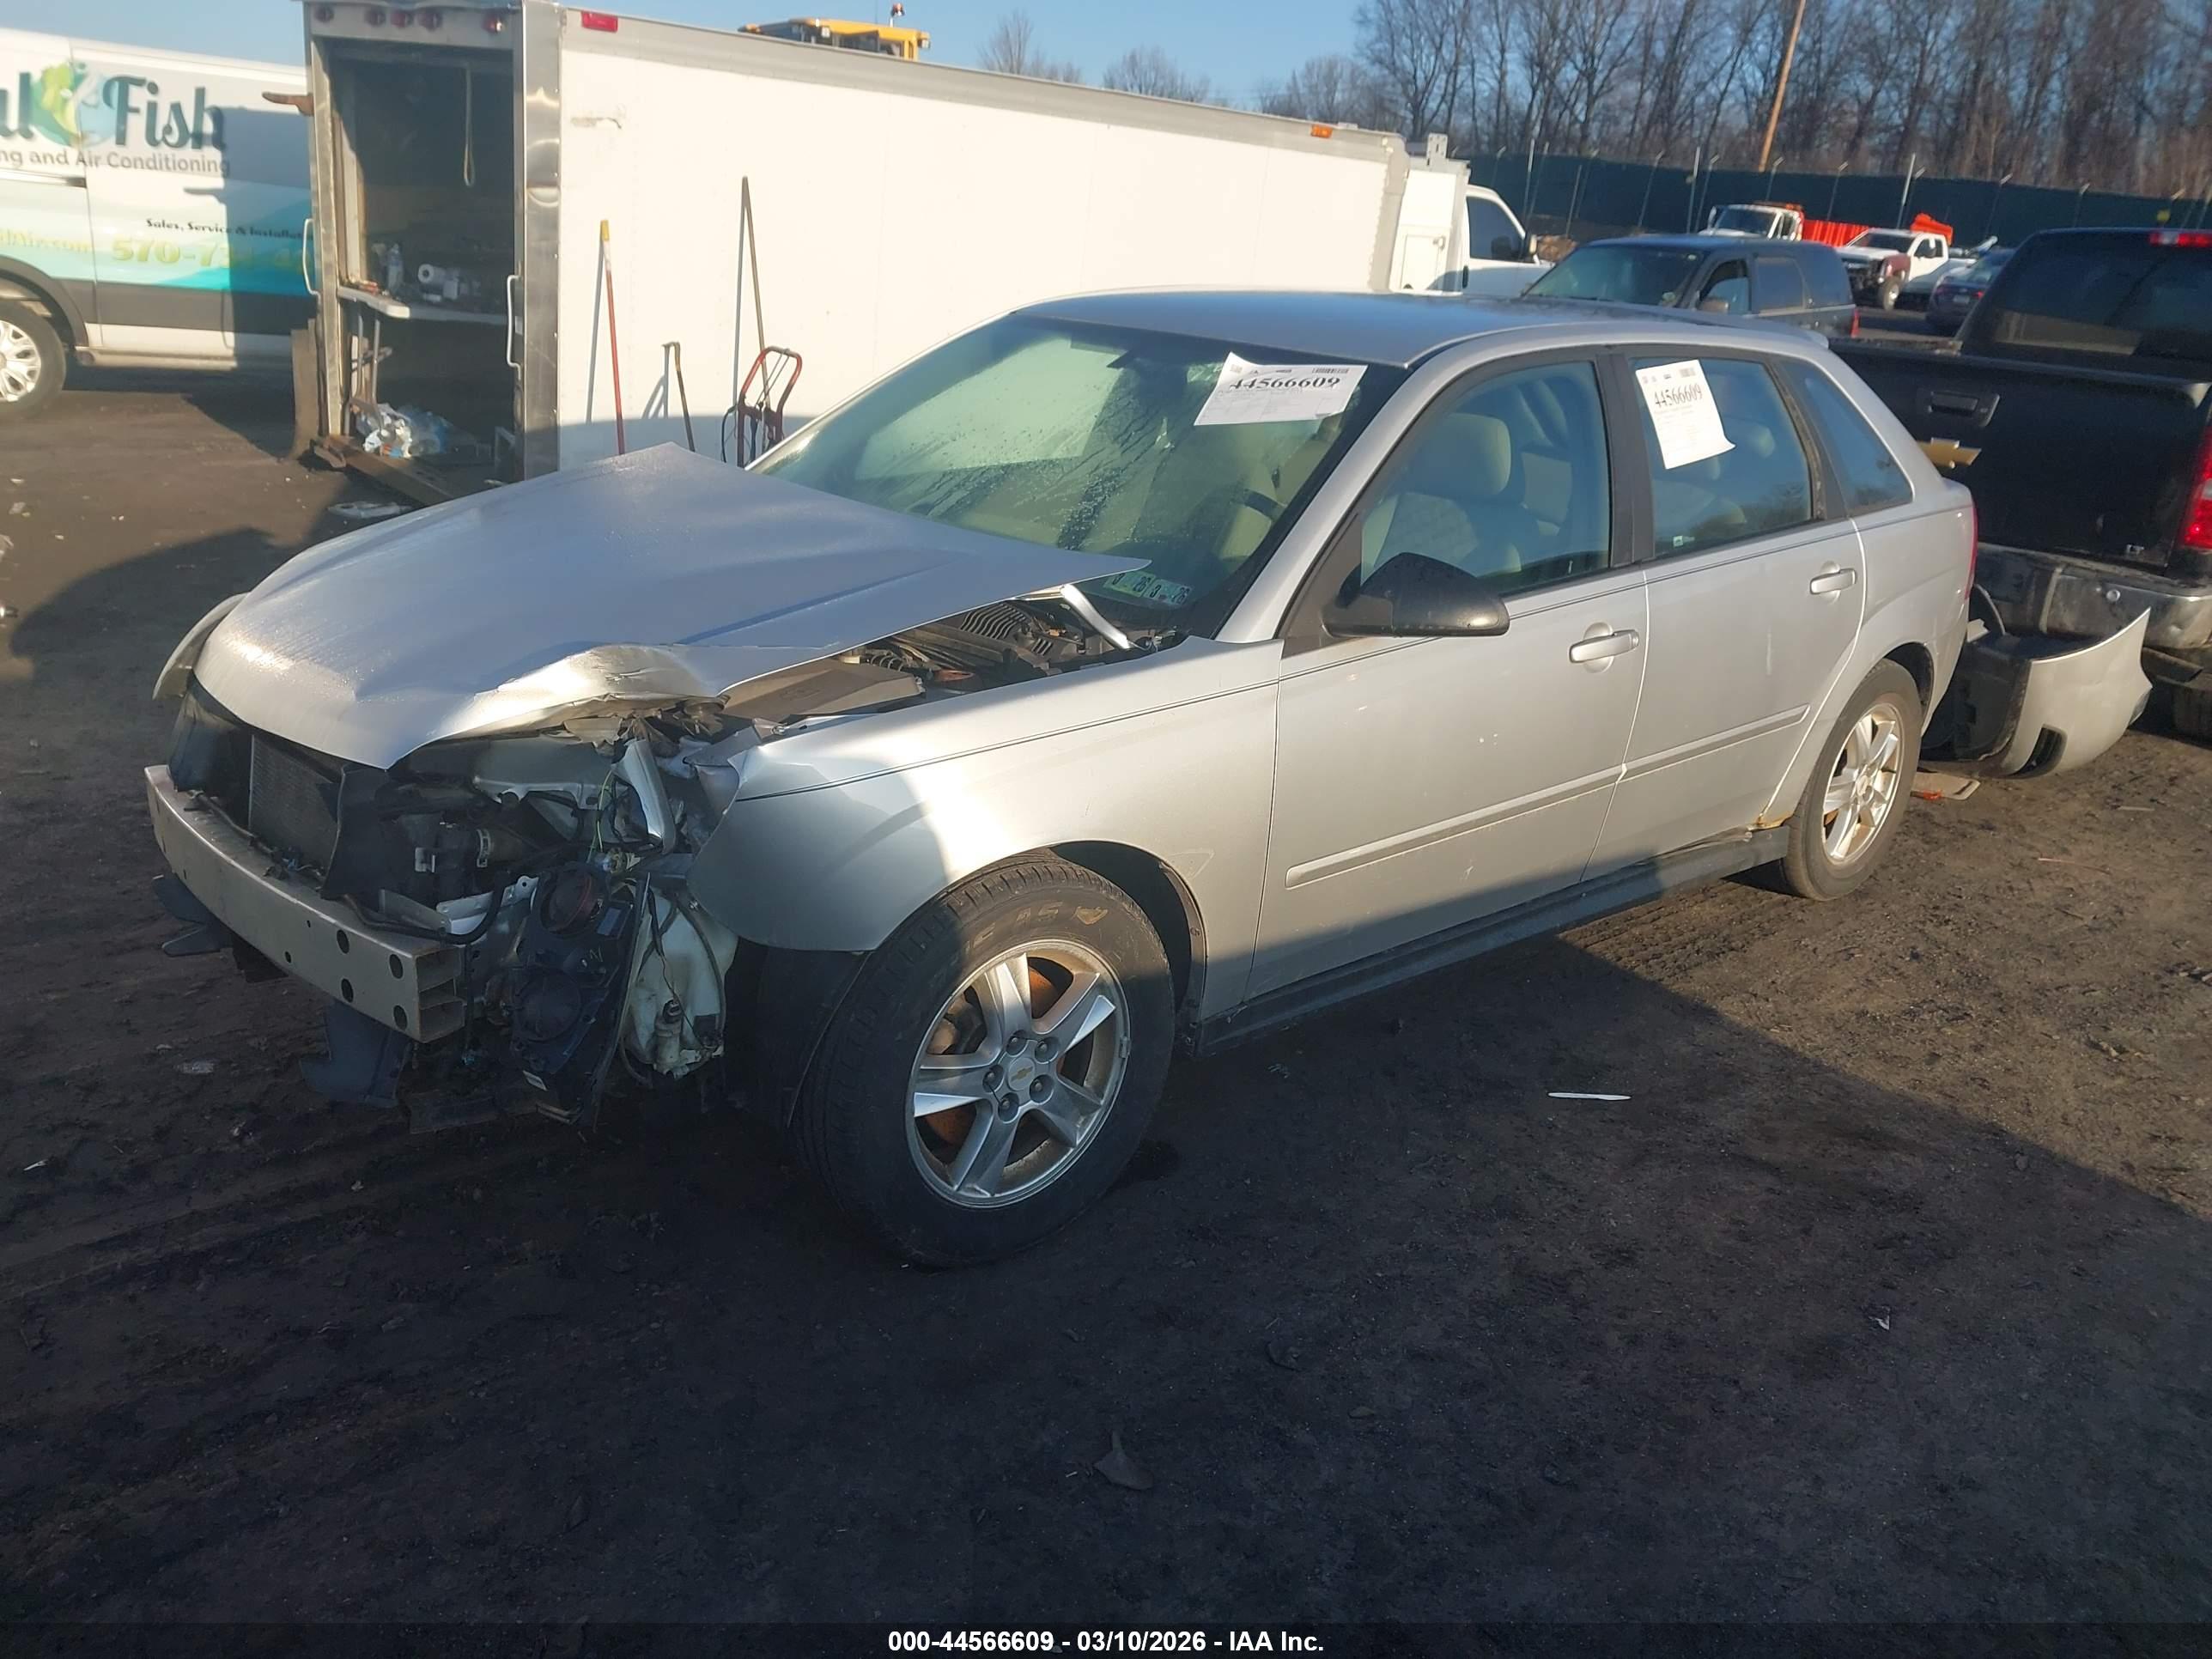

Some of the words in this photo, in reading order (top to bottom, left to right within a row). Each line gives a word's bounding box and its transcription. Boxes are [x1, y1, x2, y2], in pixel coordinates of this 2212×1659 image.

[102, 76, 227, 153] Fish
[29, 149, 69, 165] and
[76, 150, 101, 167] Air
[106, 151, 230, 178] Conditioning
[187, 222, 230, 234] Service
[235, 226, 246, 236] &
[1229, 376, 1340, 390] 44566609
[1655, 384, 1702, 407] 44566609
